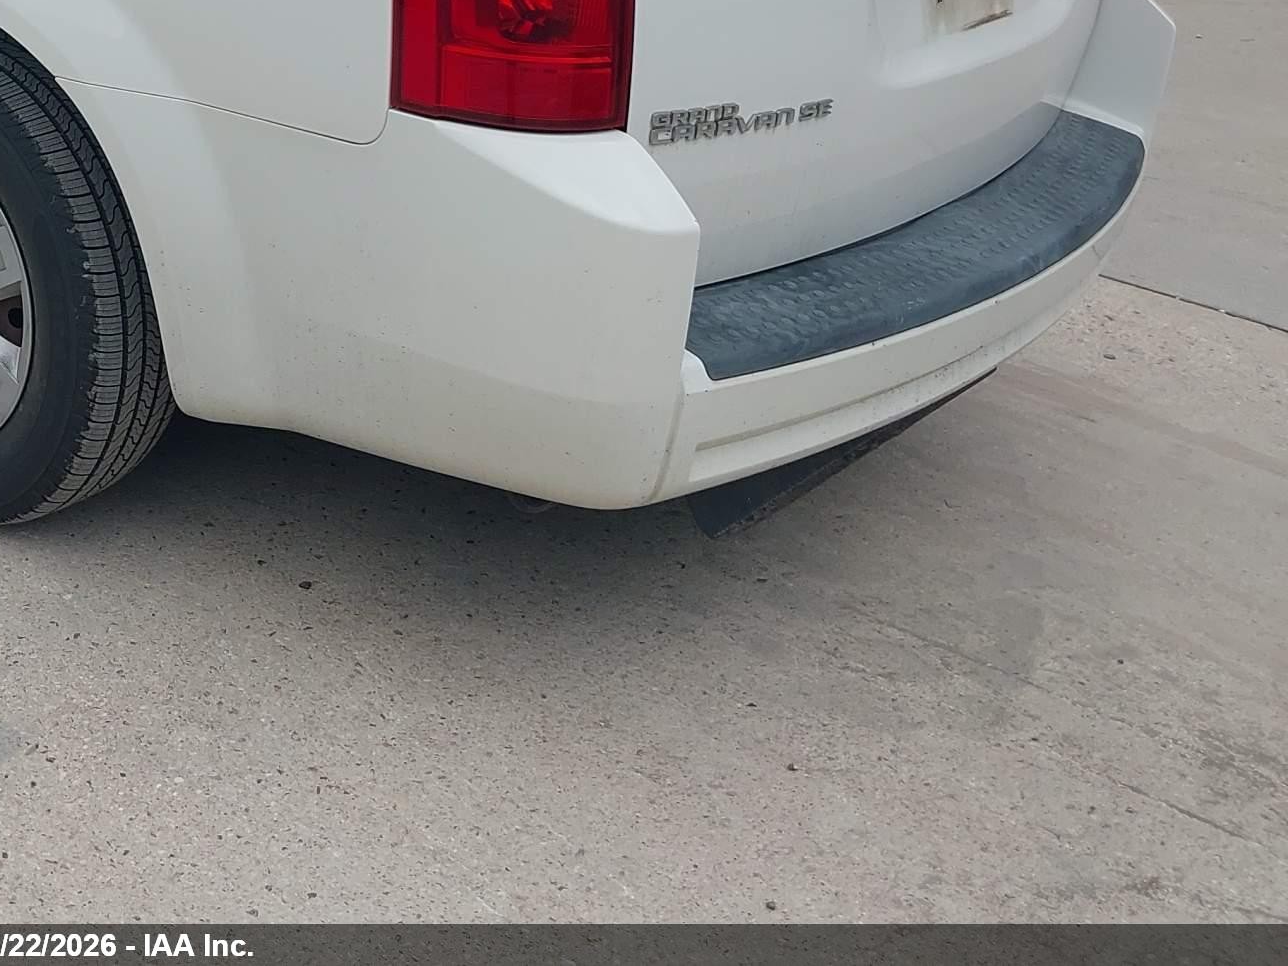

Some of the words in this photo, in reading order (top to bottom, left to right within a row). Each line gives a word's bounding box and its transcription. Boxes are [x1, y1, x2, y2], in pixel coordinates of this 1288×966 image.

[649, 108, 796, 146] CARAVAN
[799, 98, 834, 123] SE
[650, 102, 740, 129] GRAND
